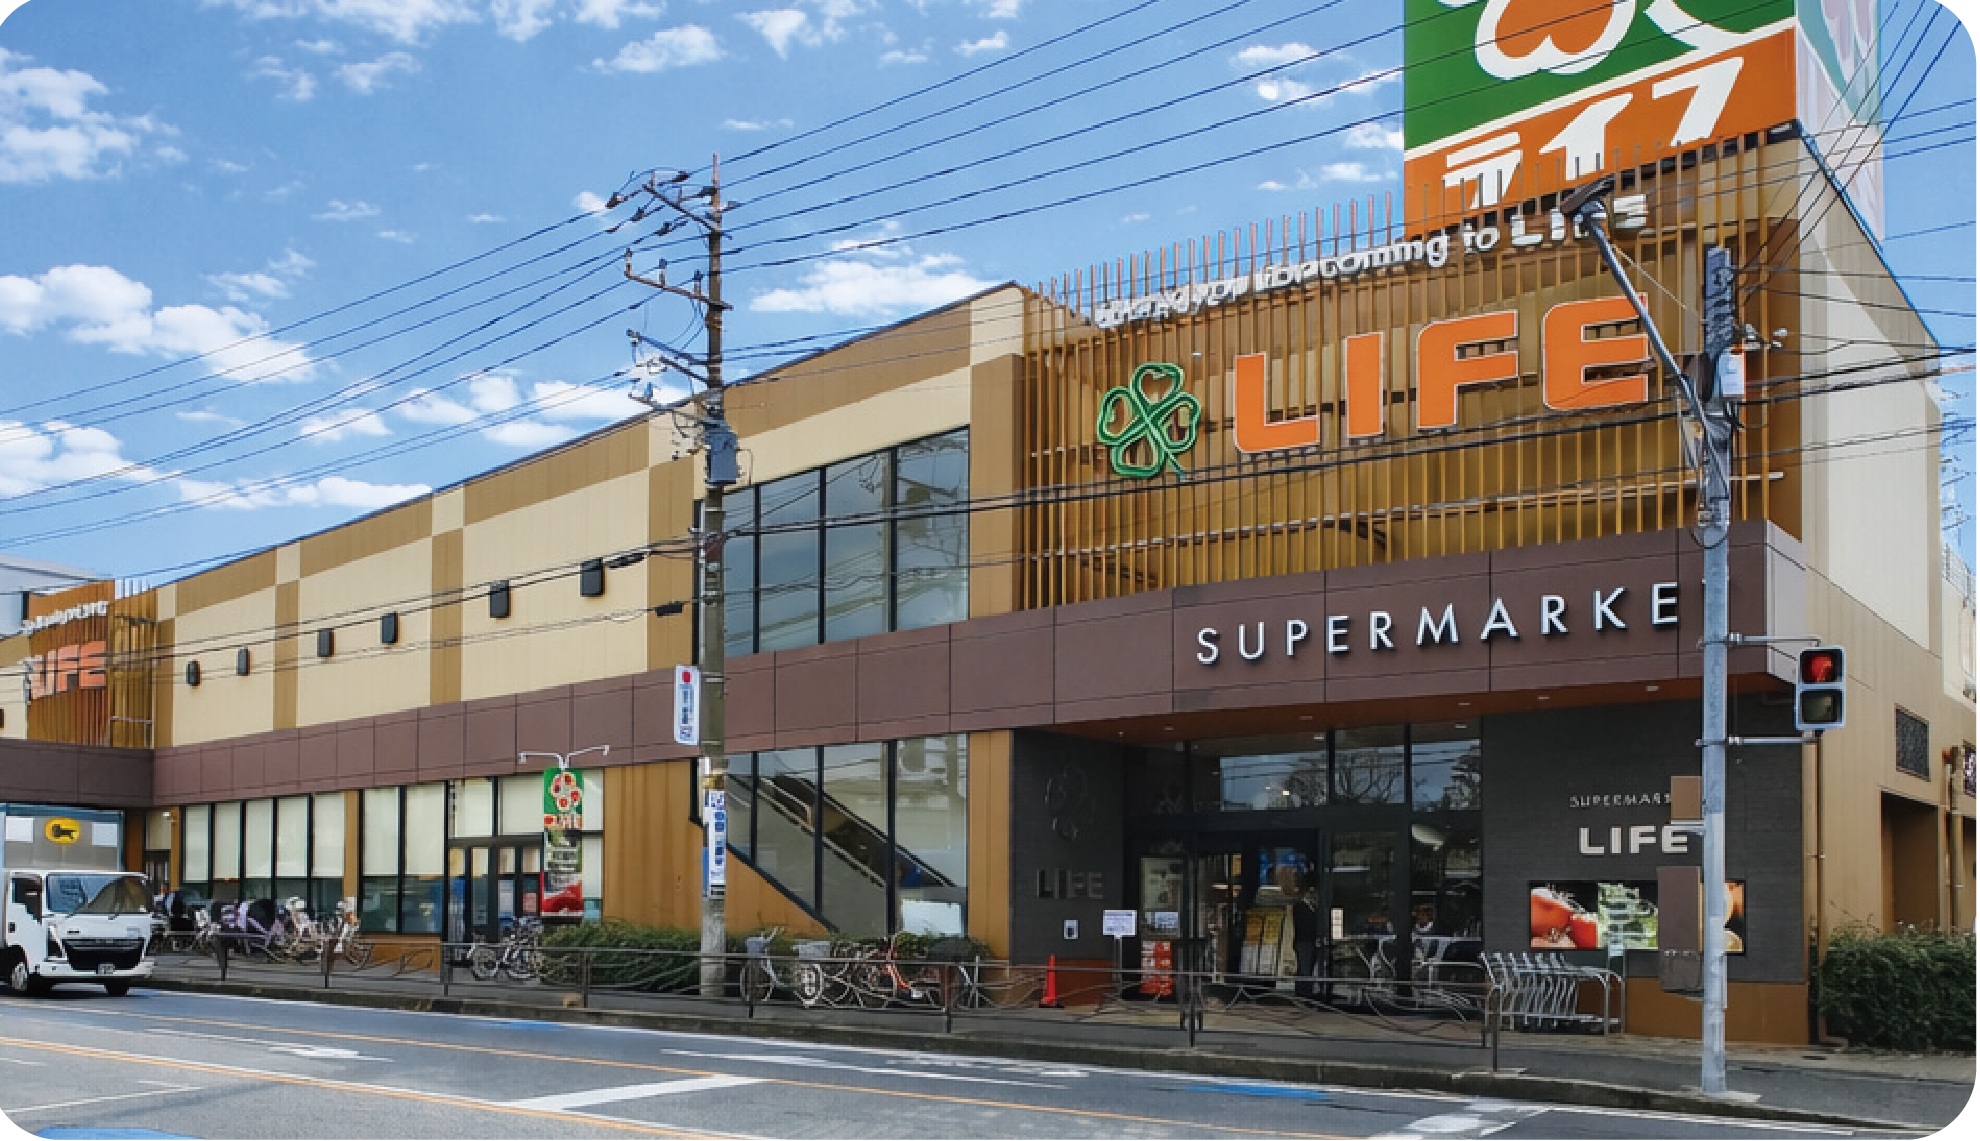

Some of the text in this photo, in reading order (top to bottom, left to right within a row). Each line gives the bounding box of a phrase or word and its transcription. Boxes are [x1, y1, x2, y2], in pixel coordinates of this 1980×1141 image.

[1442, 56, 1745, 209] ライフ
[1463, 224, 1500, 253] to
[1235, 292, 1649, 453] LIFE
[1196, 576, 1730, 664] SUPERMARKE
[1569, 792, 1672, 808] SUPERMAR
[1579, 825, 1688, 855] LIFE
[1036, 868, 1104, 900] LIFE
